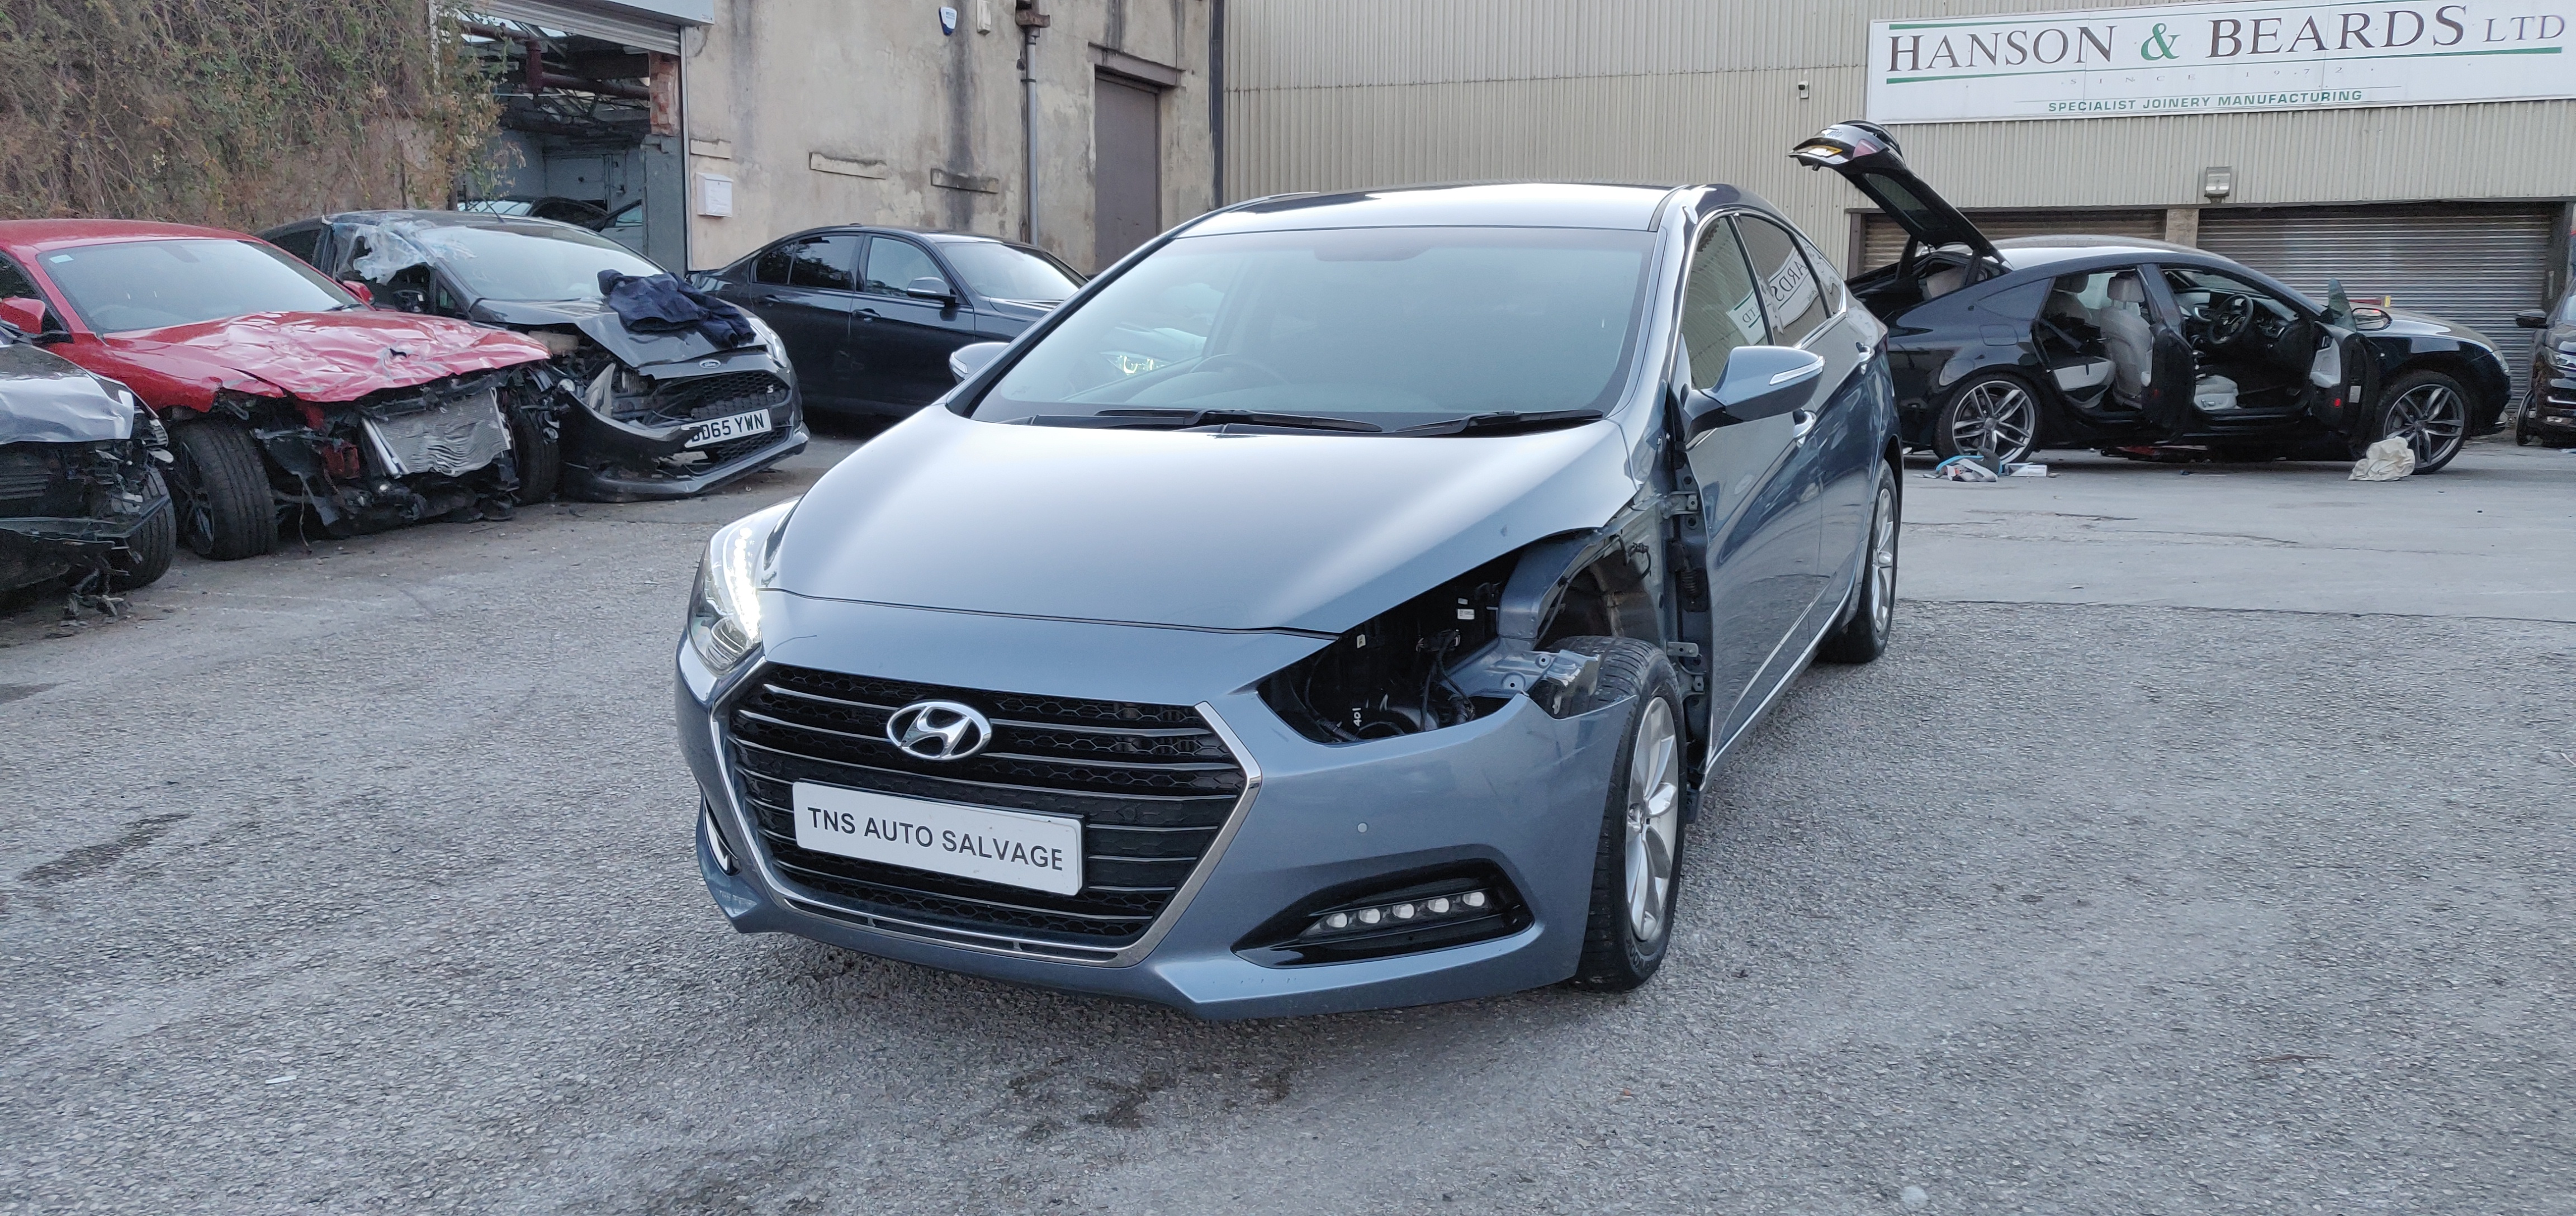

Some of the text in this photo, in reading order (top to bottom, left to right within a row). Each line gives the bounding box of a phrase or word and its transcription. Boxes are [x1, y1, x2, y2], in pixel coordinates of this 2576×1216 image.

[1887, 5, 2565, 72] HANSON & BEARDS LTD
[2048, 91, 2362, 112] SPECIALIST JOINERY MANUFACTURING
[735, 412, 765, 433] YWN
[807, 806, 1063, 871] TNS AUTO SALVAGE
